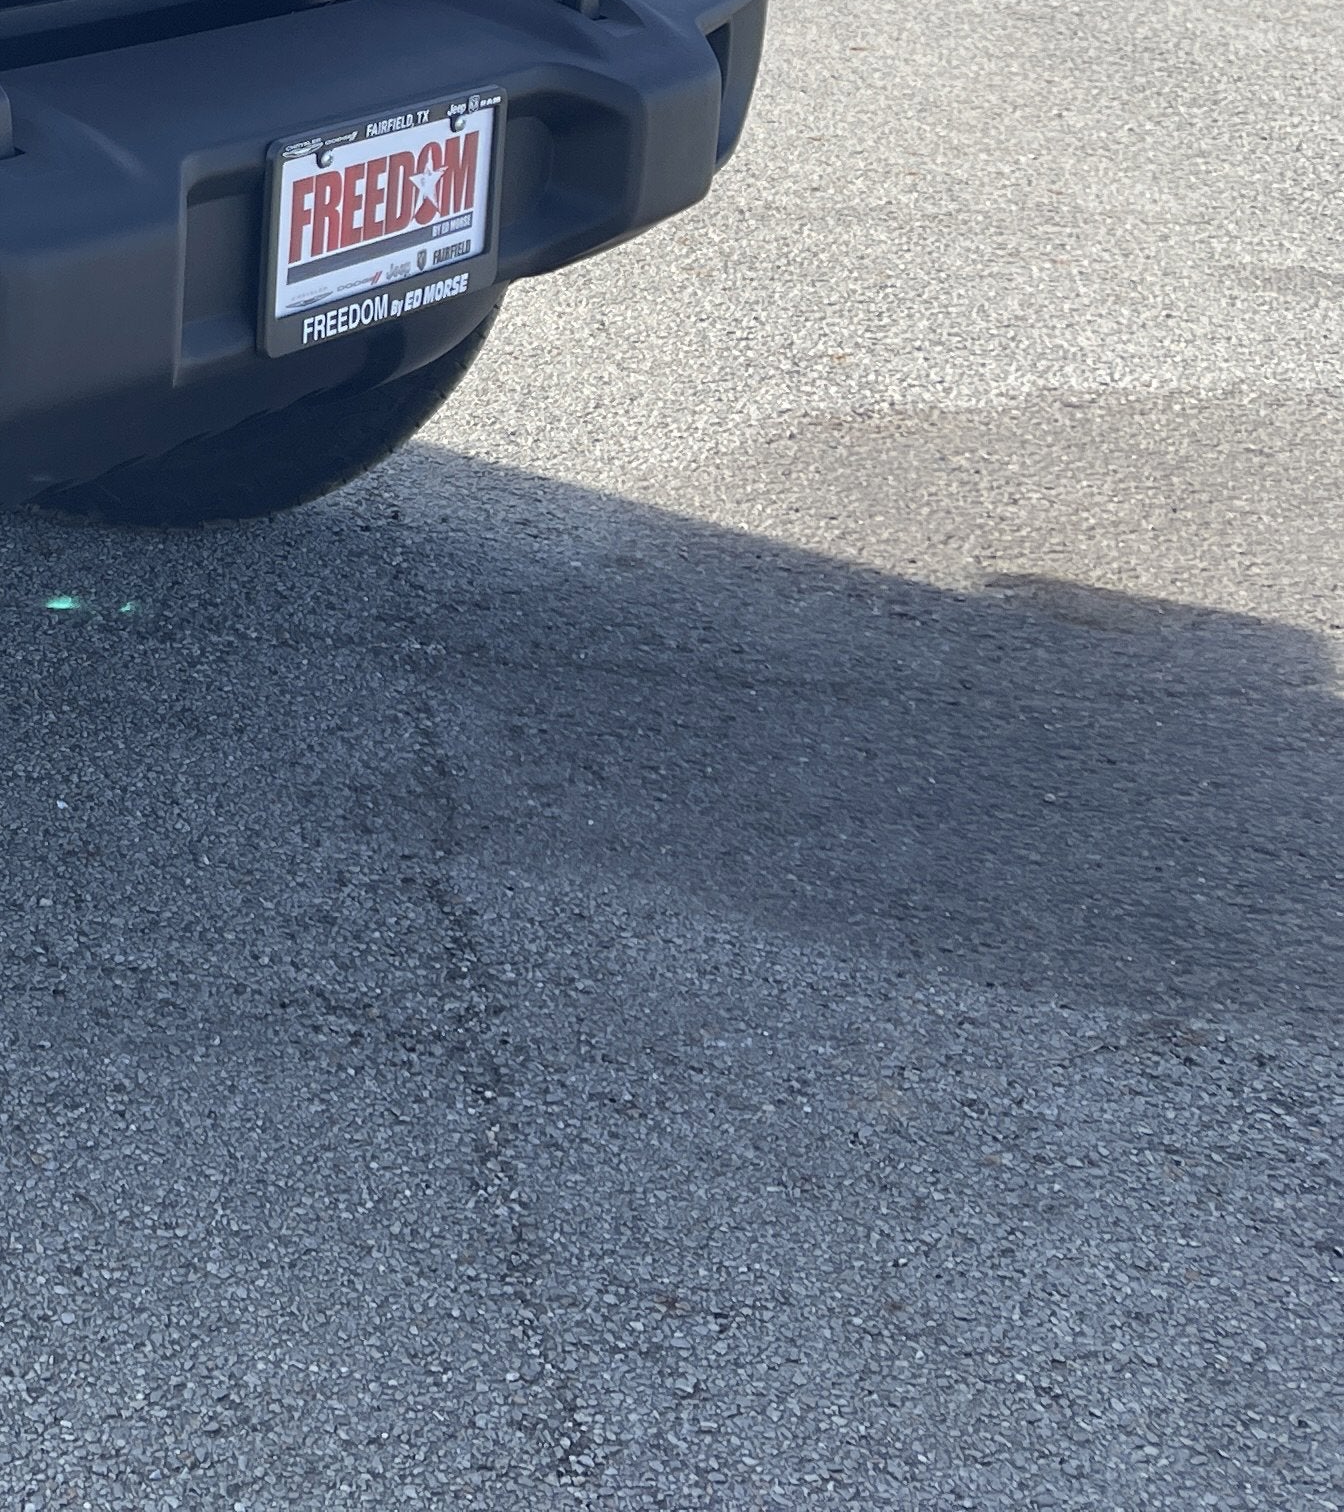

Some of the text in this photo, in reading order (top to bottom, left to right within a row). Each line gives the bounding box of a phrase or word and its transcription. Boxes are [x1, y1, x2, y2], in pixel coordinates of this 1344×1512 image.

[365, 109, 430, 139] FAIRFIELD, TX
[288, 130, 480, 264] FREEDOM
[432, 239, 471, 265] FAIRFIELD
[302, 293, 389, 345] FREEDOM
[404, 288, 422, 312] ED
[422, 272, 470, 304] MORSE
